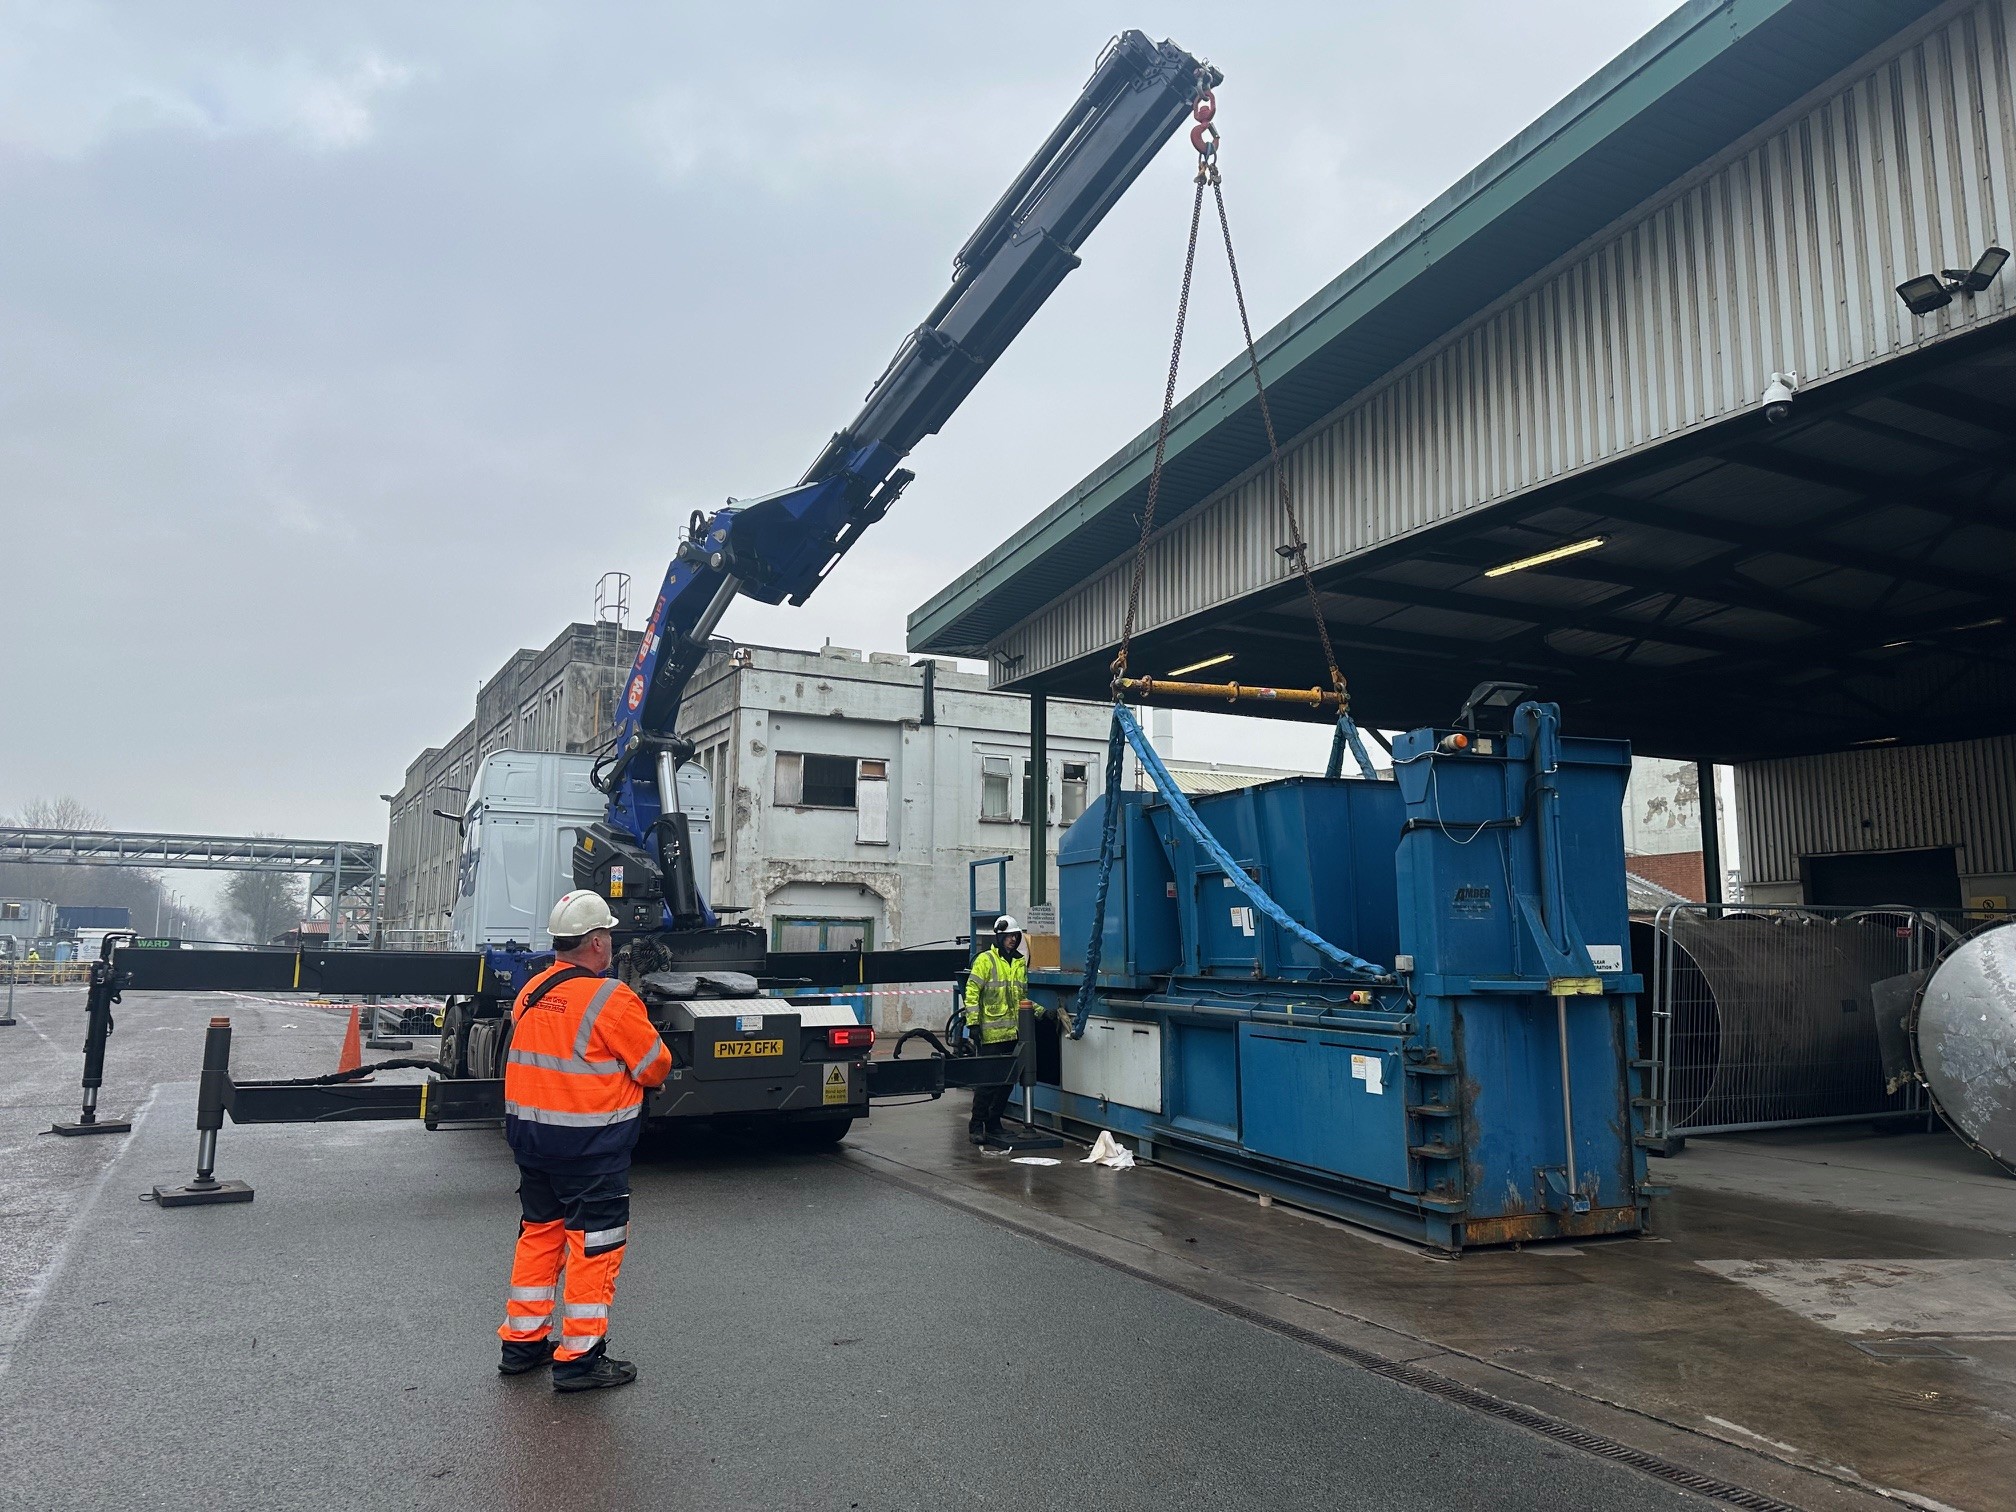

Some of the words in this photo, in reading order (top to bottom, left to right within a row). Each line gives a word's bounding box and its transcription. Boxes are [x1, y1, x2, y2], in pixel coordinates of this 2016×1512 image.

[629, 677, 644, 707] PM
[1454, 888, 1491, 901] AMBER
[137, 940, 170, 948] WARD
[719, 1043, 751, 1056] PN72
[754, 1041, 778, 1054] GFK
